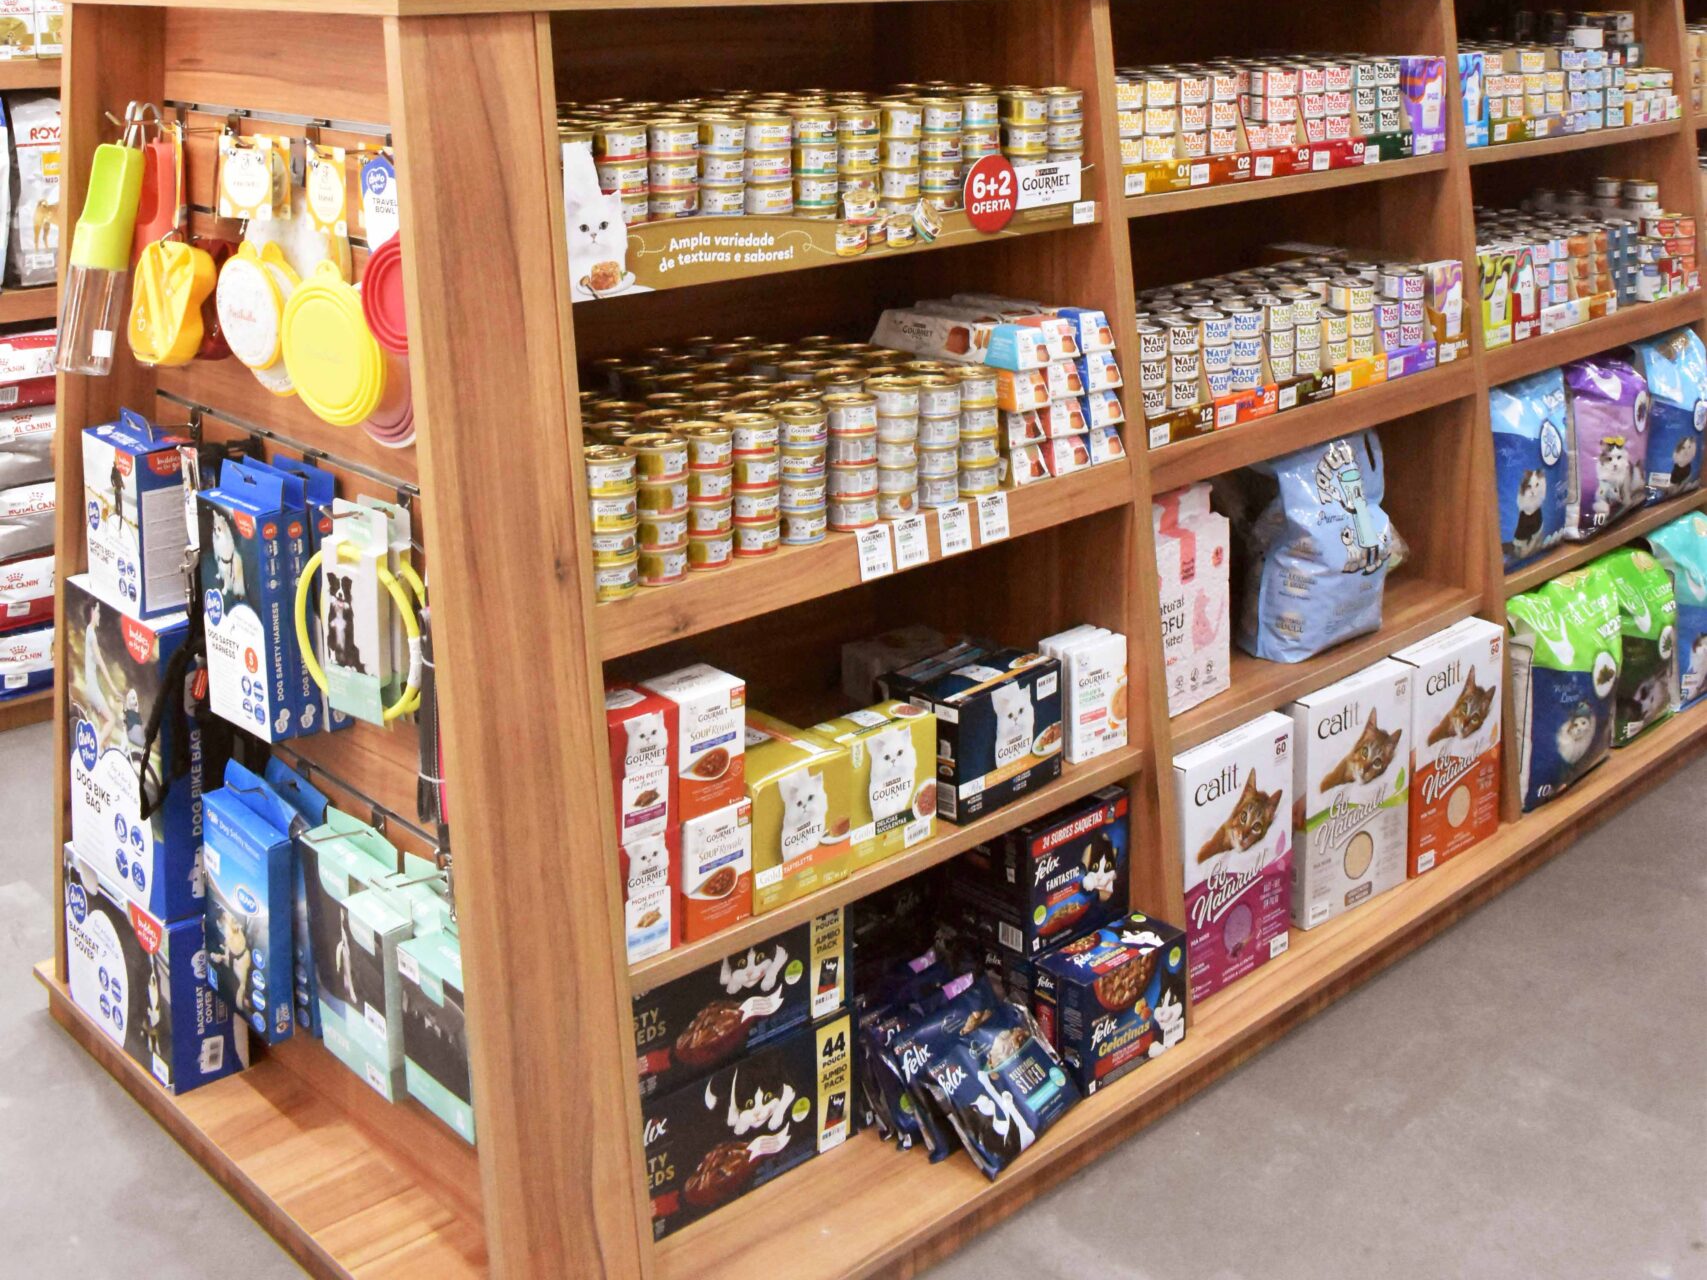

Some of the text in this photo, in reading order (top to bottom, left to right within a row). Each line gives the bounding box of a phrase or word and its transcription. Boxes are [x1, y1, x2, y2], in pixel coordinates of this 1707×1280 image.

[1328, 76, 1349, 85] CODE
[1378, 71, 1397, 79] CODE
[30, 126, 60, 141] ROY
[1298, 149, 1309, 161] 03
[1353, 142, 1364, 154] 09
[1178, 164, 1190, 177] 01
[1237, 157, 1250, 170] 02
[972, 171, 1011, 200] 6+2
[1022, 174, 1070, 191] GOURMET
[372, 198, 398, 206] TRAVEL
[375, 206, 396, 214] BOWL
[971, 199, 1011, 215] OFERTA
[669, 232, 775, 252] Ampla variedade
[659, 246, 794, 272] de texturas e sabores!
[1173, 337, 1195, 345] CODE
[1206, 330, 1228, 338] CODE
[1144, 345, 1164, 353] CODE
[1143, 373, 1164, 381] CODE
[1175, 364, 1196, 373] CODE
[1232, 375, 1256, 383] CODE
[1321, 375, 1333, 388] 24
[1263, 391, 1276, 404] 23
[1200, 408, 1213, 421] 12
[16, 579, 39, 589] CANIN
[1161, 614, 1185, 638] OFU
[212, 642, 236, 660] HARNESS
[219, 636, 240, 651] SAFETY
[271, 602, 285, 702] DOG SAFETY HARNESS
[20, 652, 42, 661] CANIN
[302, 676, 310, 697] DOG
[1079, 671, 1111, 688] GOURMET
[1426, 659, 1462, 696] catit
[698, 707, 728, 723] GOURMET
[1317, 701, 1361, 740] catit
[997, 738, 1031, 759] GOURMET
[1276, 740, 1287, 755] 60
[625, 748, 666, 766] GOURMET
[191, 730, 203, 837] DOG BIKE BAG
[629, 769, 663, 784] MON PETIT
[1194, 763, 1239, 807] catit
[76, 767, 111, 806] DOG BIKE
[872, 779, 912, 802] GOURMET
[1537, 784, 1551, 797] 10
[85, 794, 101, 814] BAG
[1329, 791, 1349, 820] Go
[706, 827, 736, 843] GOURMET
[784, 823, 823, 847] GOURMET
[1042, 810, 1103, 849] 24 SOBRES SAQUETAS
[628, 869, 667, 888] GOURMET
[1034, 856, 1060, 887] felix
[1046, 866, 1080, 892] FANTASTIC
[1208, 858, 1227, 890] Go
[648, 889, 665, 900] PETIT
[69, 920, 100, 956] BACKSEAT
[814, 928, 841, 947] JUMBO
[74, 936, 95, 961] COVER
[816, 940, 838, 955] PACK
[1037, 976, 1055, 989] felix
[196, 986, 205, 1035] BACKSEAT
[204, 991, 213, 1024] COVER
[637, 1024, 667, 1048] EDS
[1090, 1018, 1119, 1052] felix
[1098, 1021, 1150, 1057] Gelatinas
[822, 1031, 846, 1059] 44
[822, 1052, 846, 1069] POUCH
[902, 1044, 932, 1083] felix
[821, 1063, 848, 1083] JUMBO
[938, 1066, 968, 1096] felix
[1015, 1063, 1046, 1095] SLICED
[824, 1076, 845, 1090] PACK
[644, 1117, 667, 1147] lix
